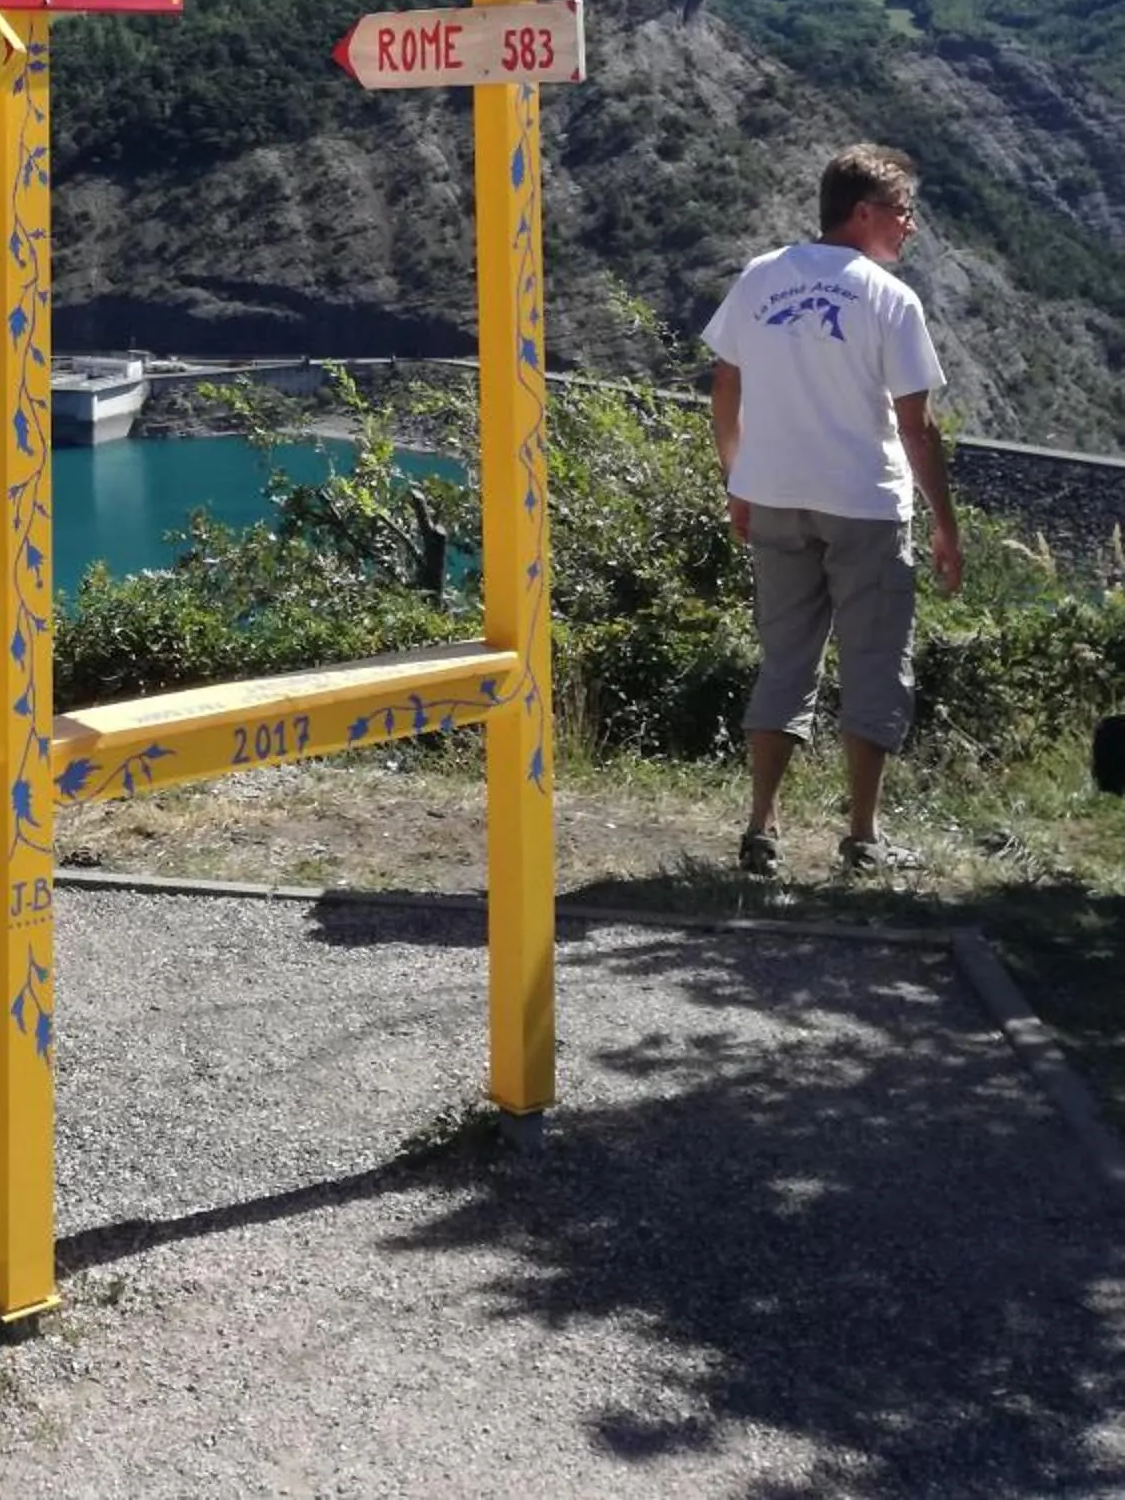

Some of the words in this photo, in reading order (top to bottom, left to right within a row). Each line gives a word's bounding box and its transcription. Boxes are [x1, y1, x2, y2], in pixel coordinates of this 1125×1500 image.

[377, 20, 465, 72] ROME
[501, 28, 555, 71] 583
[231, 716, 311, 765] 2017
